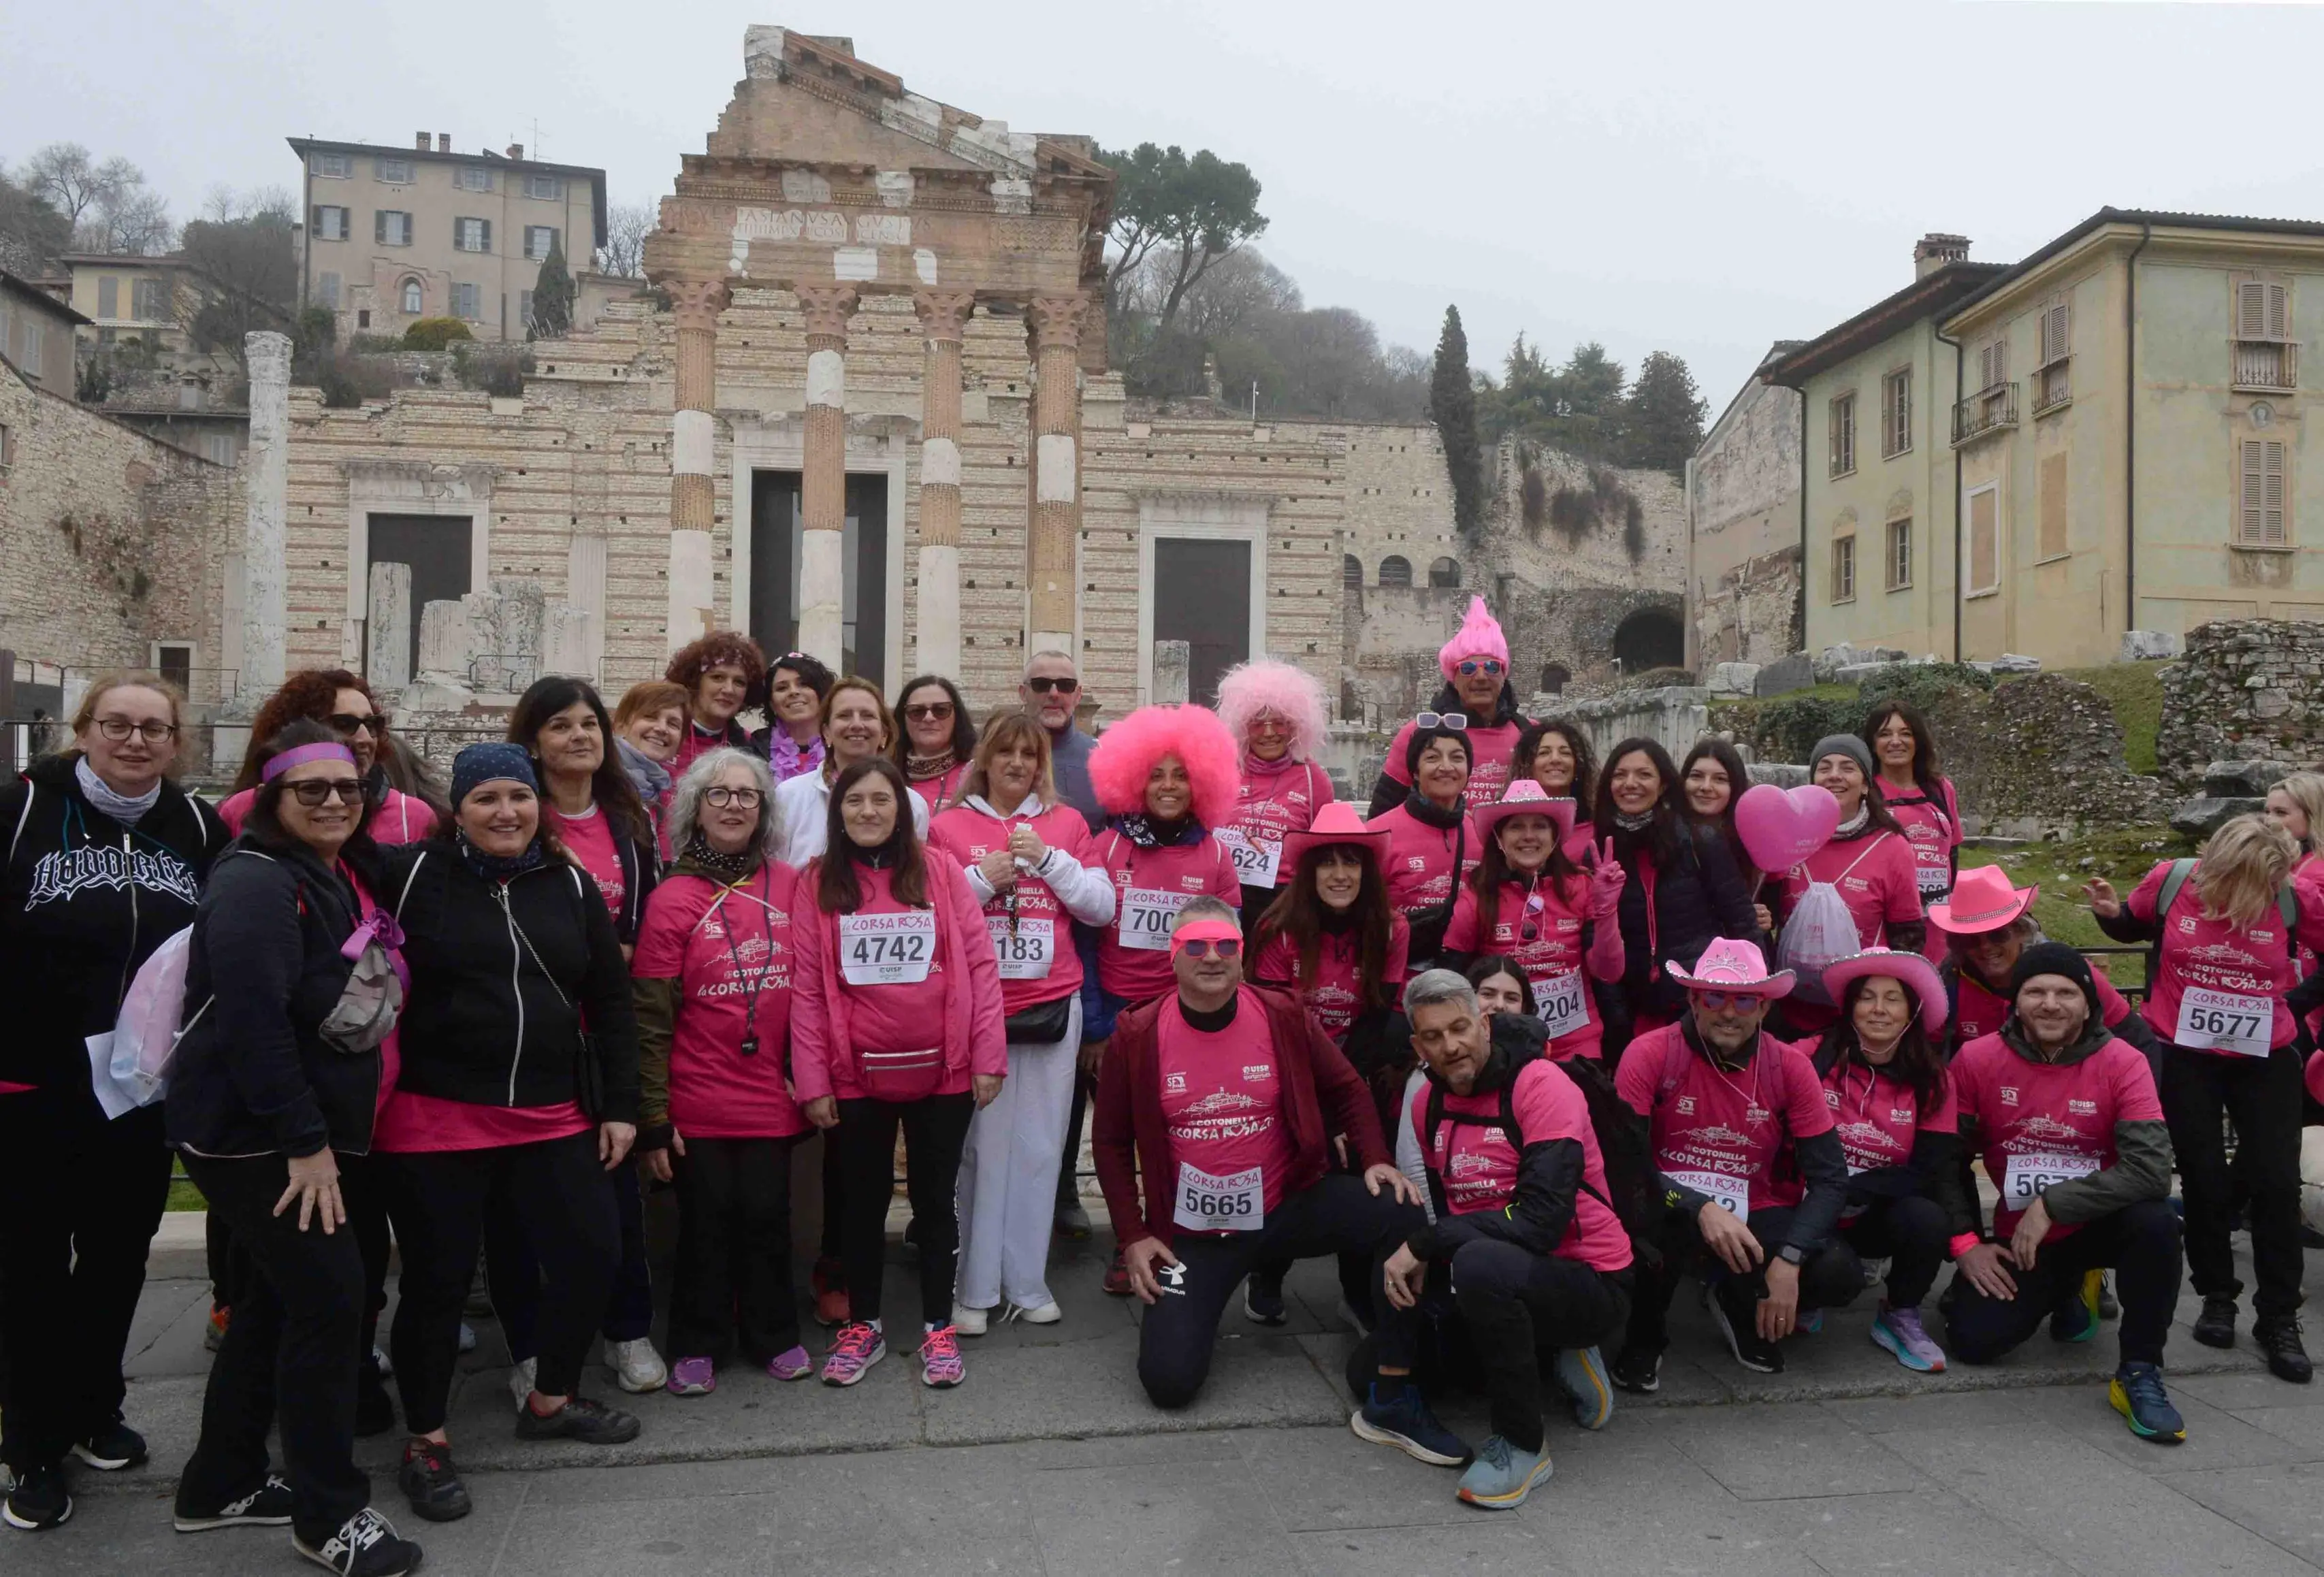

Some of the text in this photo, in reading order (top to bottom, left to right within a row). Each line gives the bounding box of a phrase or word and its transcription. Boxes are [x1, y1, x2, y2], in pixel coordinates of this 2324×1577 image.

[1462, 790, 1491, 800] ORSA
[1244, 817, 1287, 830] COTONELLA
[1231, 847, 1270, 873] 624
[1018, 897, 1048, 909] ROSA
[1133, 892, 1169, 906] CORSA
[852, 918, 894, 930] CORSA
[898, 914, 932, 928] ROSA
[988, 920, 1052, 933] ORS ROSA
[1132, 908, 1175, 934] 700
[853, 935, 924, 964] 4742
[997, 936, 1044, 962] 183
[2177, 966, 2218, 986] CORSA
[2221, 976, 2257, 990] ROSA
[2195, 964, 2253, 979] COTONELLA
[708, 980, 756, 996] CORSA
[759, 975, 790, 990] ROSA
[1532, 983, 1559, 996] ORSA
[1541, 990, 1579, 1022] 204
[2193, 992, 2270, 1011] CORSA ROSA
[2189, 1007, 2261, 1038] 5677
[1250, 1064, 1270, 1073] UISP
[1196, 1116, 1256, 1126] COTONELLA
[1176, 1126, 1219, 1141] CORSA
[1223, 1121, 1258, 1139] ROSA
[1841, 1143, 1891, 1163] OTONELLA
[2020, 1137, 2080, 1151] COTONELLA
[1668, 1150, 1711, 1170] CORSA
[1714, 1160, 1748, 1174] ROSA
[1692, 1146, 1747, 1162] COTONELLA
[2018, 1157, 2059, 1169] CORSA
[2061, 1158, 2097, 1170] ROSA
[1187, 1171, 1224, 1190] CORSA
[1227, 1172, 1259, 1189] ROSA
[1671, 1173, 1745, 1194] CORSA ROSA
[1185, 1187, 1253, 1216] 5665
